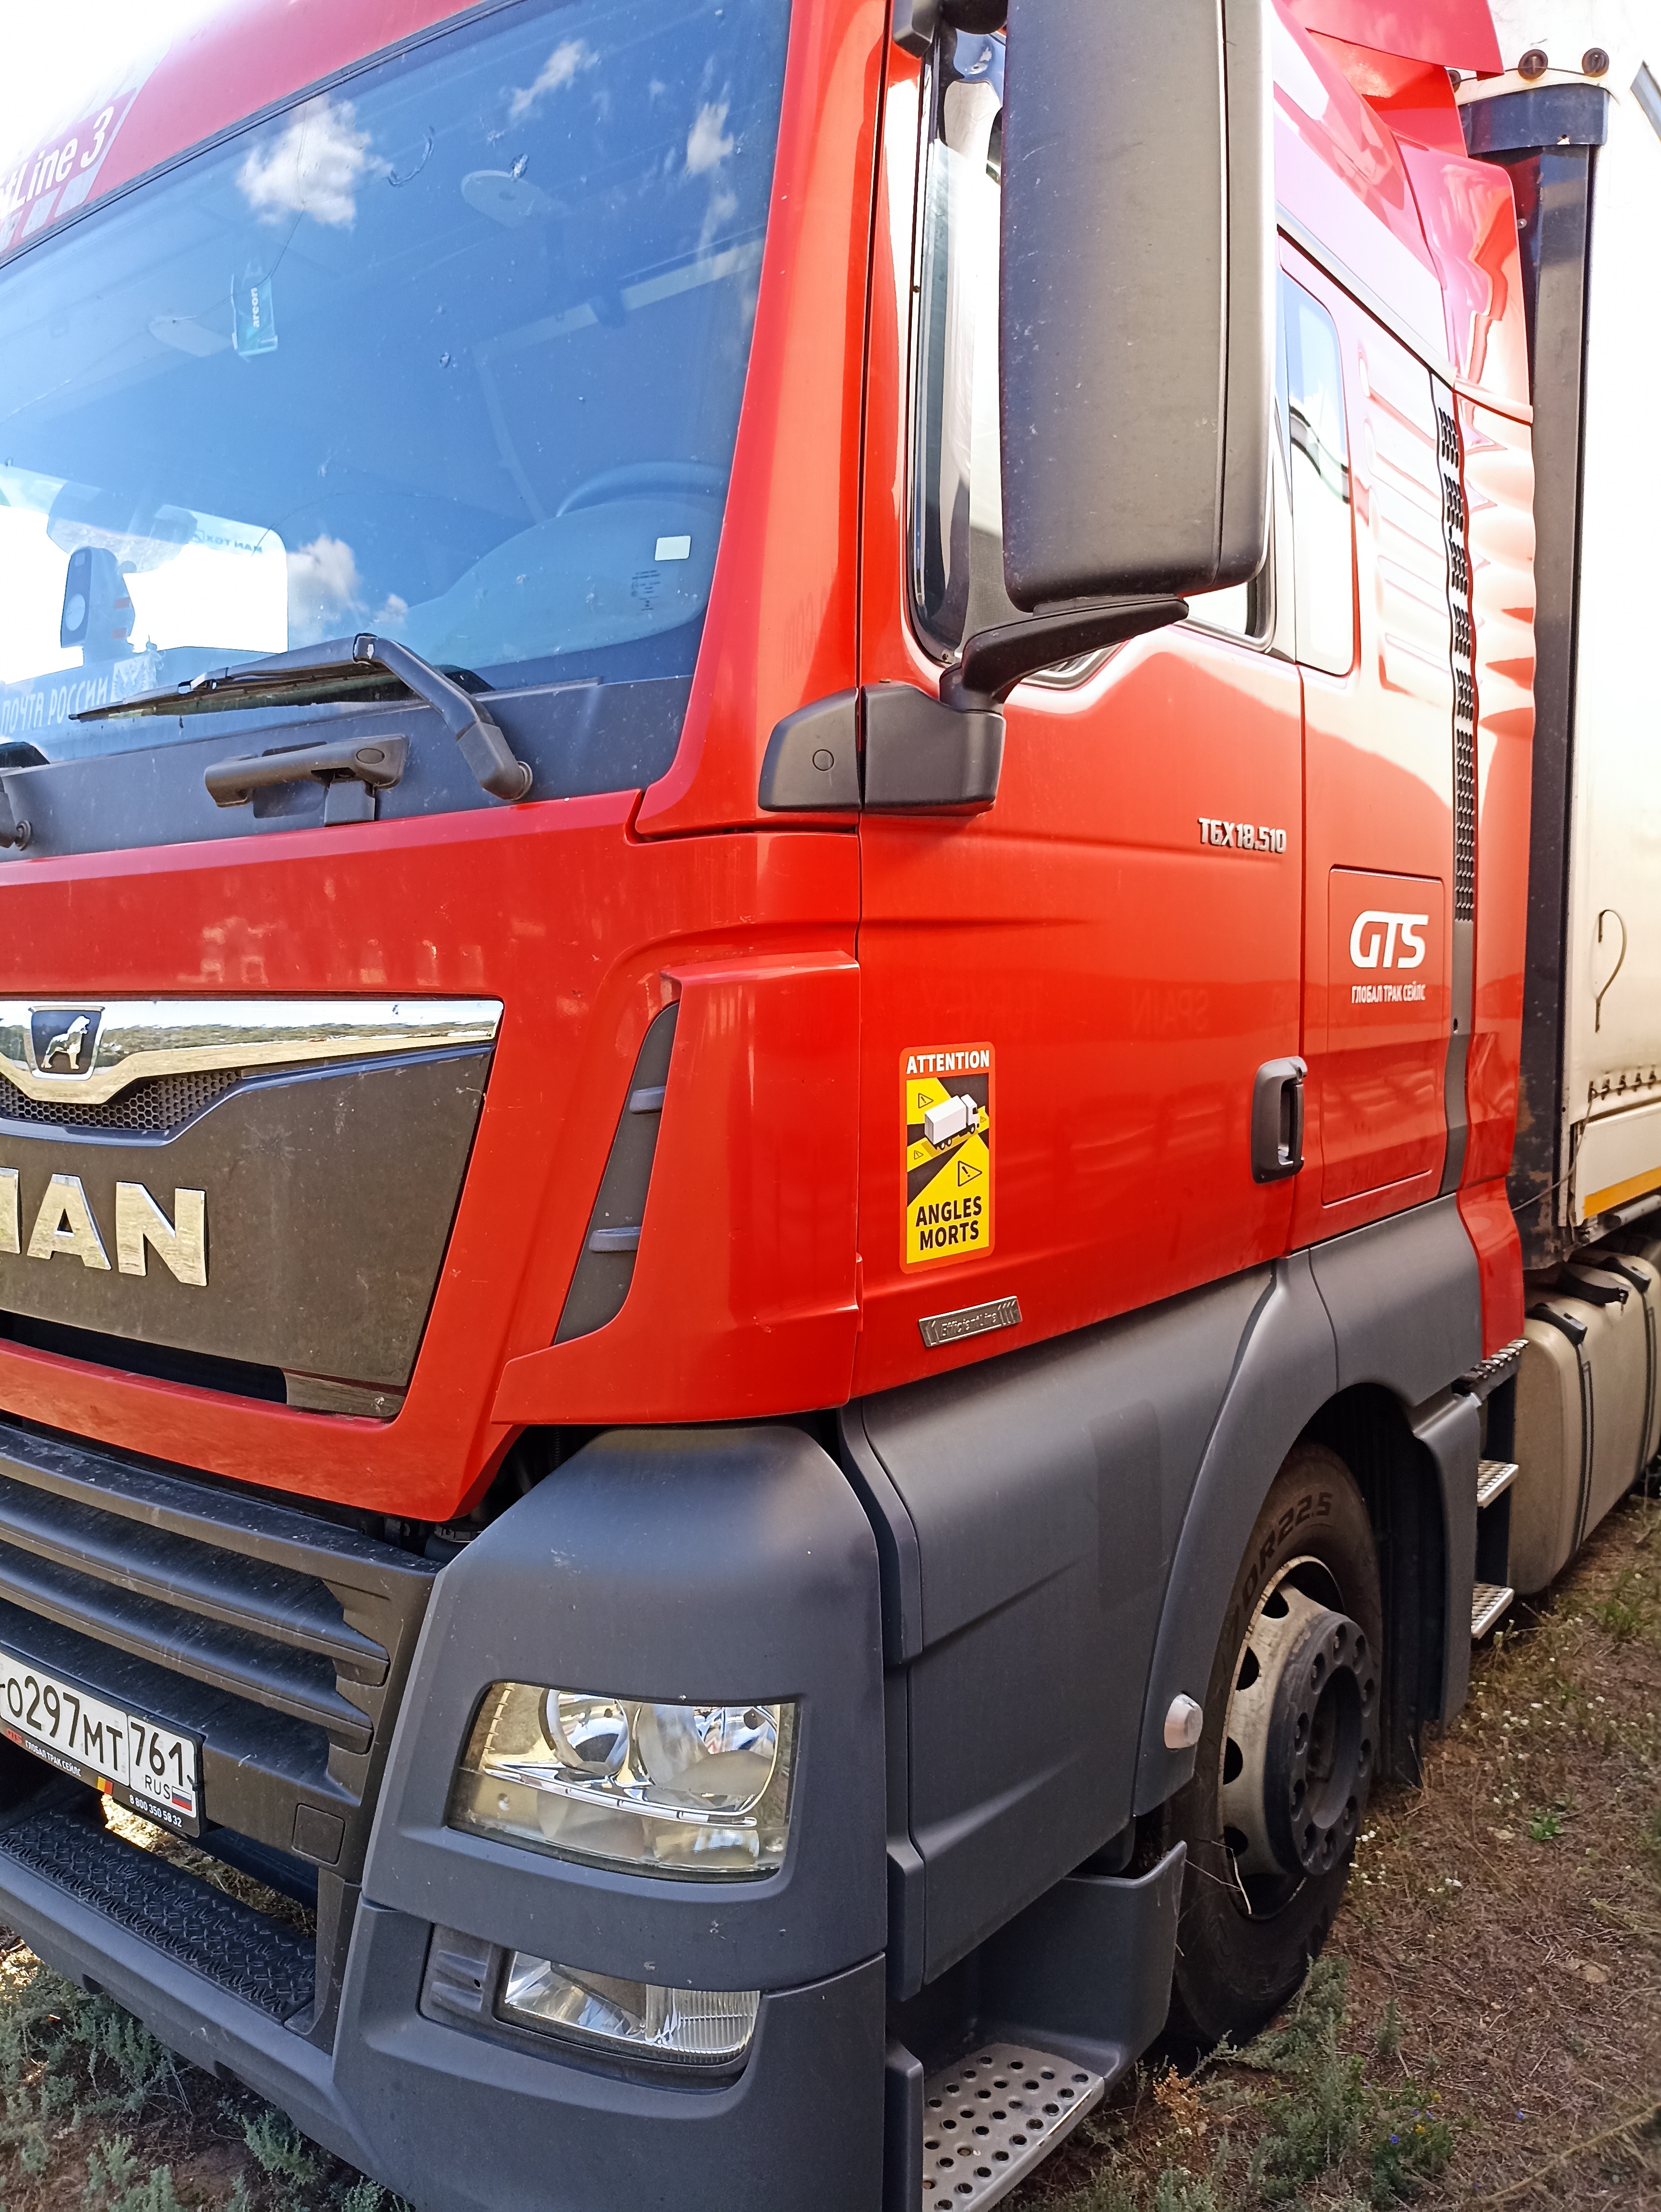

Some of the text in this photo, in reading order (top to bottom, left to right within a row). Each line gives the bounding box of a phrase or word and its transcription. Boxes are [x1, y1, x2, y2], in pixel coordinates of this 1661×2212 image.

[80, 106, 114, 168] 3
[1, 675, 109, 735] ПОЧТА РОССИИ
[1350, 910, 1429, 969] GTS
[1351, 981, 1426, 1004] ГЛОБАЛ ТРАК СЕЙЛС
[906, 1050, 990, 1074] ATTENTION
[0, 1167, 207, 1286] AN
[916, 1195, 982, 1227] ANGLES
[920, 1220, 979, 1250] MORTS
[46, 1752, 62, 1768] ТРАК
[62, 1761, 81, 1777] СЕЙЛС
[131, 1721, 183, 1787] 761
[145, 1774, 170, 1800] RUS
[130, 1794, 182, 1827] 8 800 350 58 32
